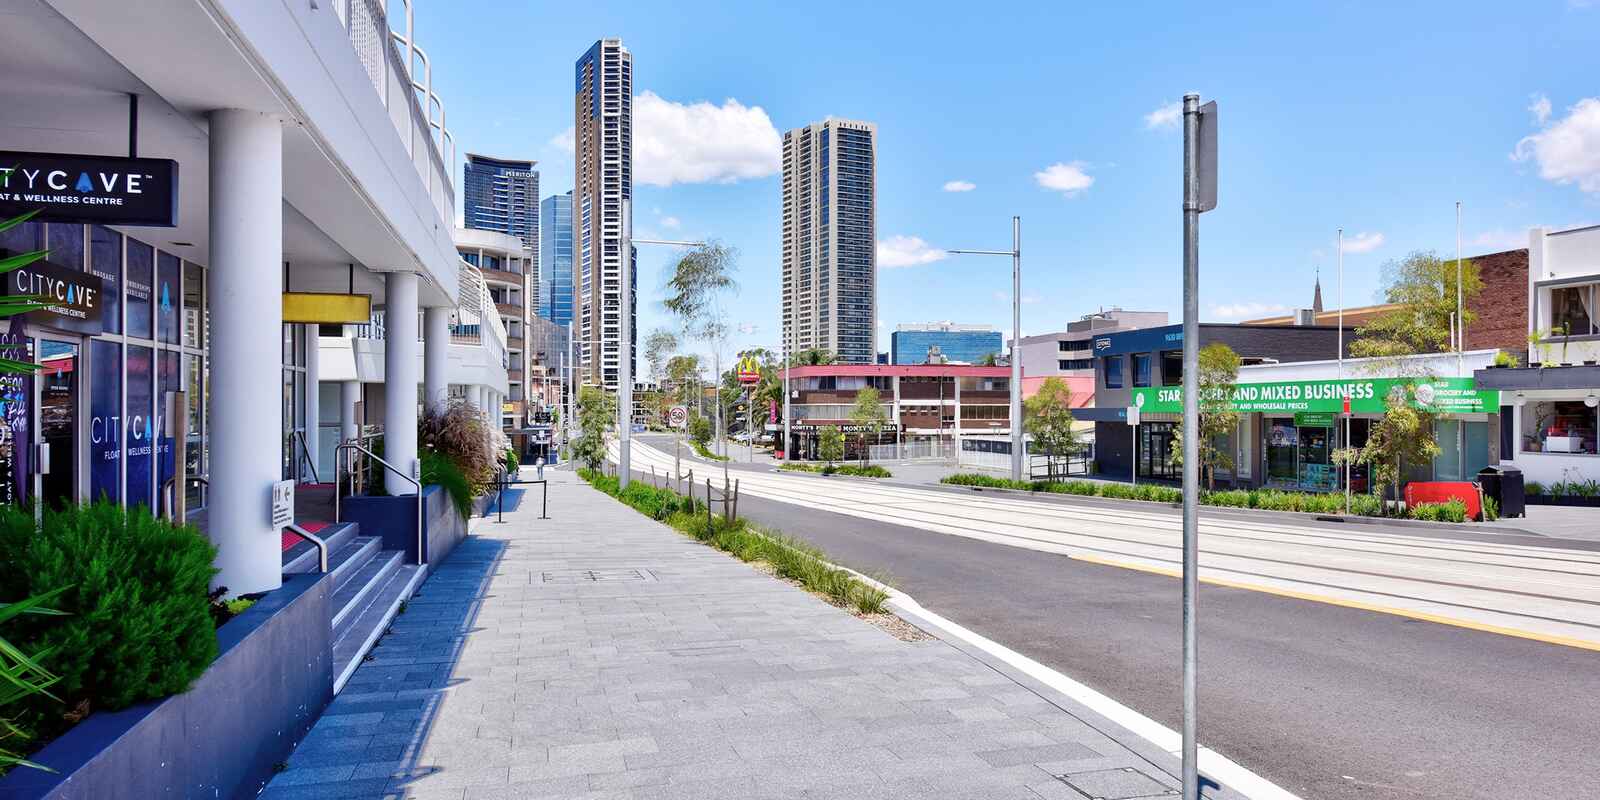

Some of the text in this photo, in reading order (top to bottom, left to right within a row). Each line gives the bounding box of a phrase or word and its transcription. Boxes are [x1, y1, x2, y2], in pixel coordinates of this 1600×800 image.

[24, 195, 79, 203] WELLNESS
[82, 196, 123, 205] CENTRE
[1158, 390, 1180, 402] STAR
[1232, 387, 1258, 400] AND
[1261, 385, 1301, 400] MIXED
[1305, 383, 1374, 399] BUSINESS
[672, 411, 683, 420] 50
[104, 449, 120, 460] FLOAT
